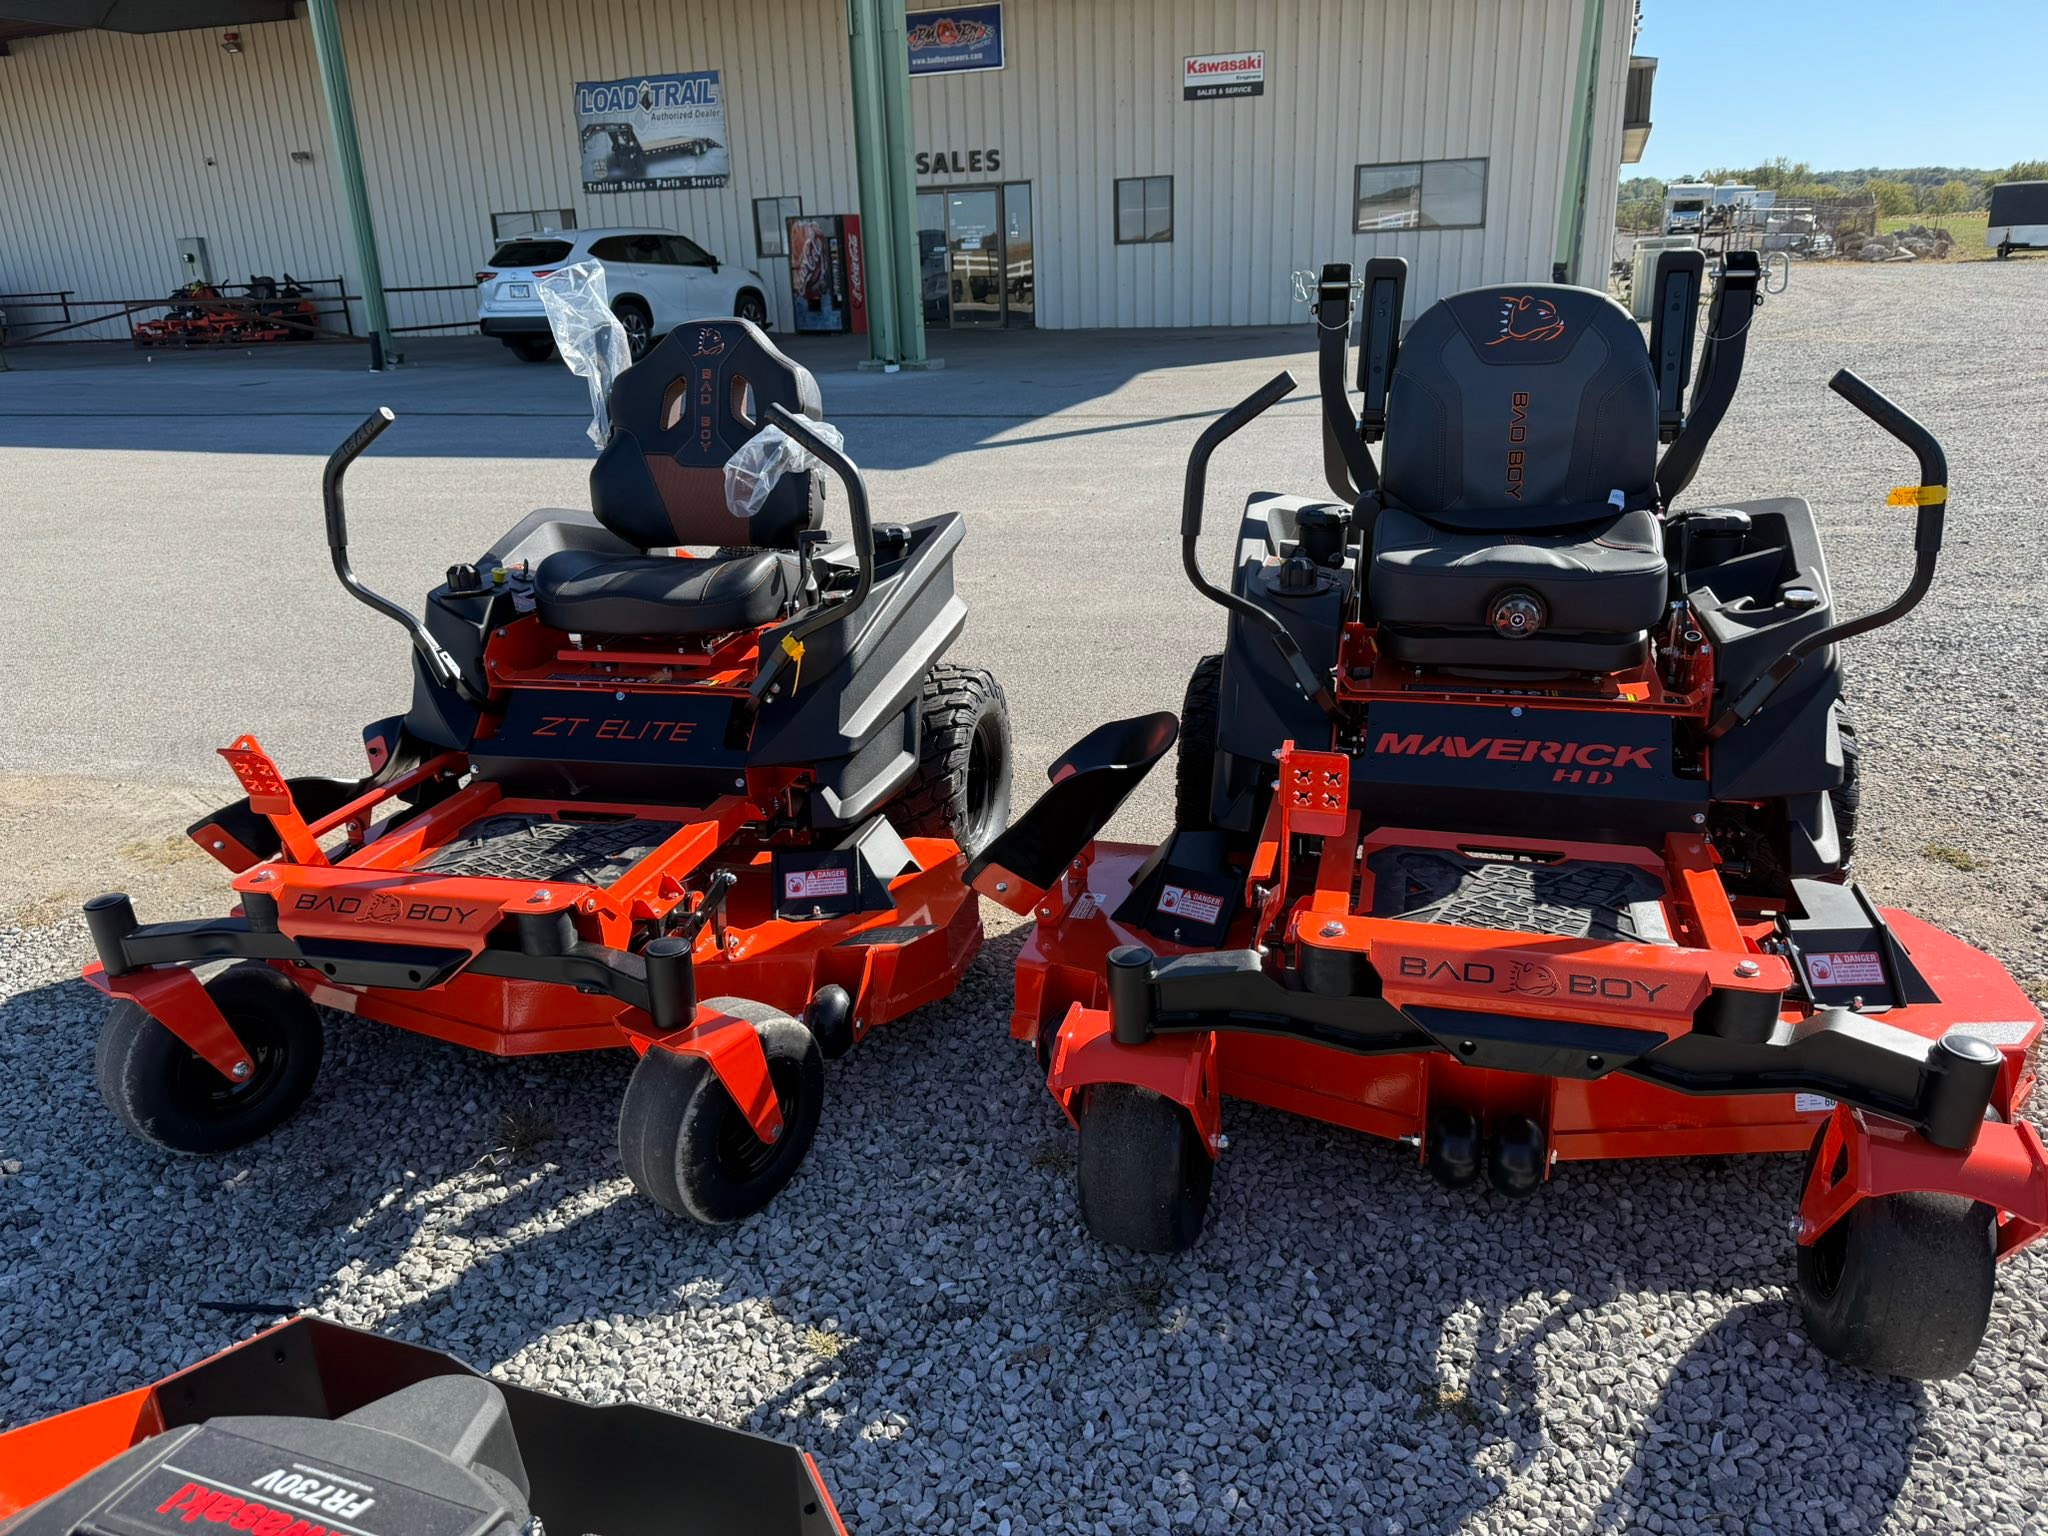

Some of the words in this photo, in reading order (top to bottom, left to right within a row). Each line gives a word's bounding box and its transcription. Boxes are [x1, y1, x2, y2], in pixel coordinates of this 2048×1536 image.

[1187, 55, 1262, 74] Kawasaki
[581, 86, 639, 114] LOAD
[648, 79, 716, 107] TRAIL
[1196, 88, 1217, 96] SALES
[1225, 86, 1252, 94] SERVICE
[651, 110, 693, 121] Authorized
[694, 109, 721, 119] Dealer
[915, 150, 1001, 174] SALES
[587, 182, 618, 192] Trailer
[621, 181, 646, 190] Sales
[656, 179, 680, 188] Parts
[700, 368, 712, 405] BAD
[1508, 391, 1530, 443] BAD
[700, 416, 712, 453] BOY
[1504, 449, 1525, 501] BOY
[532, 716, 590, 737] ZT
[595, 719, 697, 742] ELITE
[1374, 732, 1661, 769] MAVERICK
[1552, 768, 1616, 785] HD
[817, 870, 845, 879] DANGER
[295, 893, 362, 914] BAD
[406, 902, 479, 924] BOY
[1193, 893, 1222, 906] DANGER
[1844, 954, 1877, 963] DANGER
[1400, 955, 1495, 984] BAD
[1568, 973, 1670, 1003] BOY
[251, 1468, 376, 1520] FR730V
